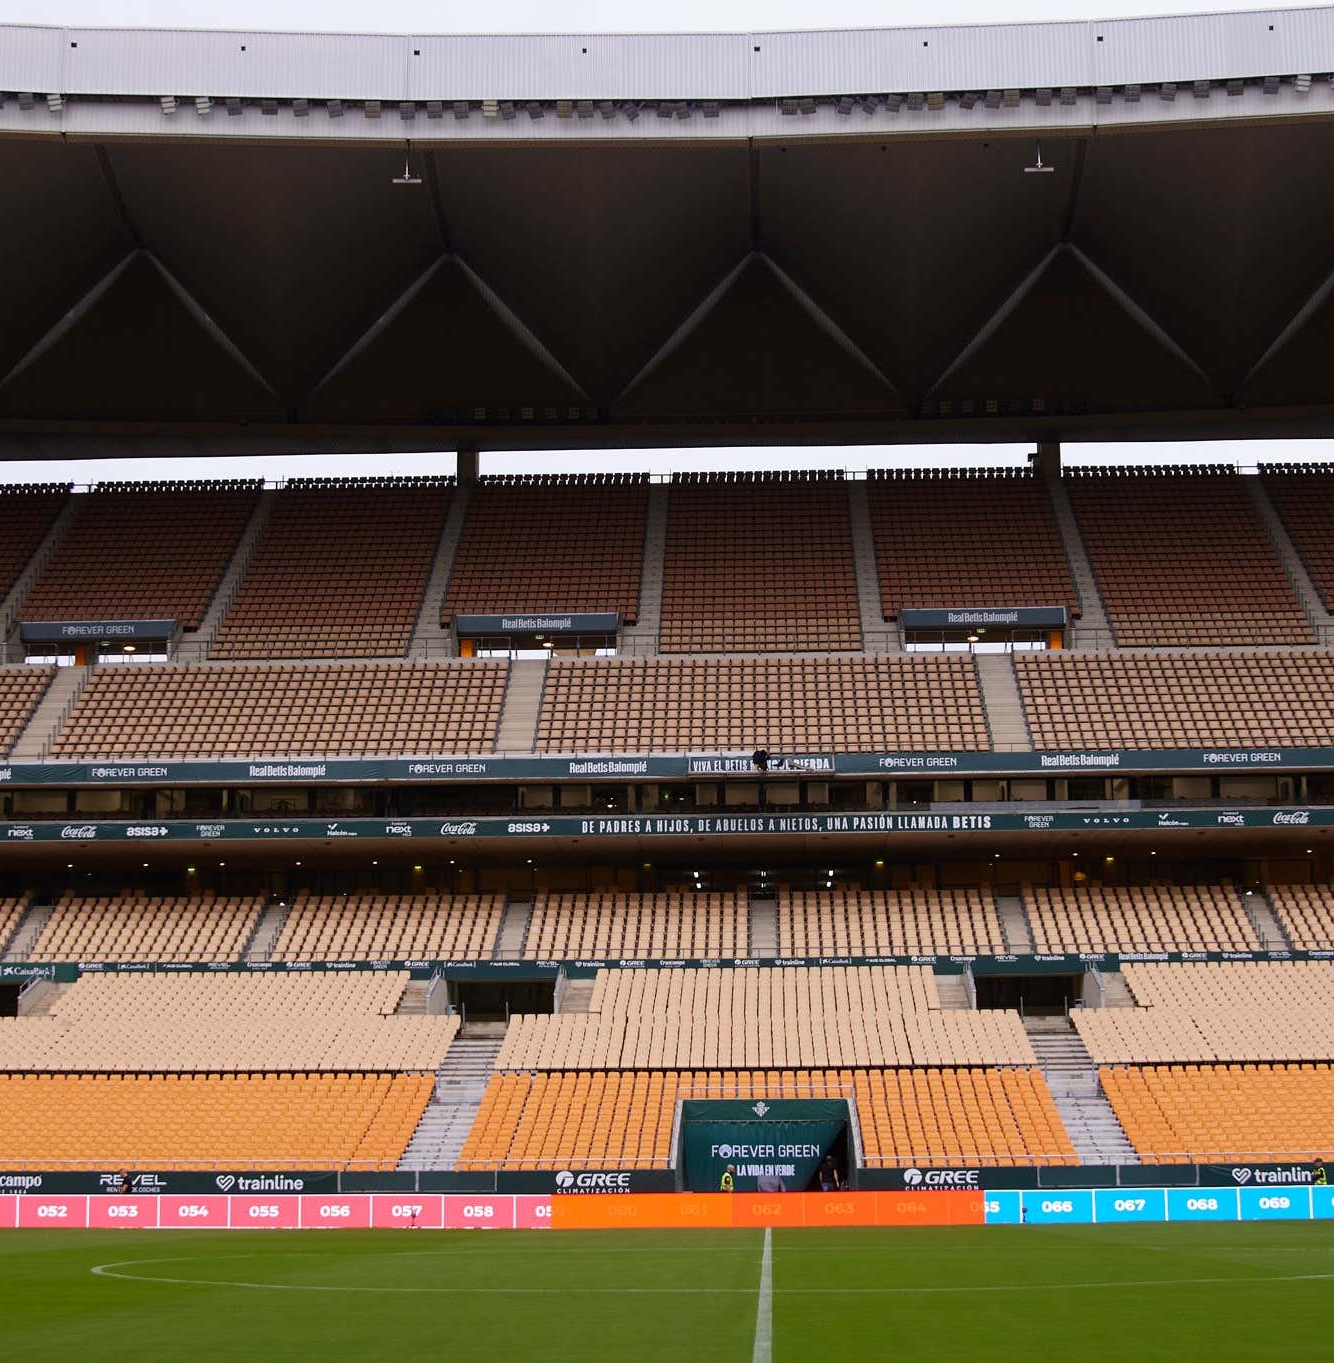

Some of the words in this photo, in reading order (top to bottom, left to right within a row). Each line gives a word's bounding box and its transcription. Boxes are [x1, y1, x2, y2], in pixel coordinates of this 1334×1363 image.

[503, 619, 518, 628] Real
[519, 619, 536, 628] Betis
[537, 619, 571, 628] Balompié
[62, 626, 104, 634] FOREVER
[879, 758, 924, 766] FOREVER
[926, 758, 957, 766] GREEN
[1203, 754, 1249, 762] FOREVER
[1250, 753, 1281, 761] GREEN
[91, 768, 136, 776] FOREVER
[137, 768, 168, 776] GREEN
[570, 763, 587, 773] Real
[588, 762, 608, 773] Betis
[609, 762, 646, 772] Balompié
[693, 761, 711, 774] VIVA
[714, 761, 722, 773] EL
[725, 761, 748, 773] BETIS
[440, 823, 478, 834] Coca-Cola
[507, 823, 541, 832] asisa
[582, 821, 594, 833] DE
[600, 821, 640, 832] PADRES
[646, 820, 651, 832] A
[657, 820, 693, 832] HIJOS,
[699, 819, 710, 831] DE
[716, 819, 763, 831] ABUELOS
[769, 819, 774, 830] A
[780, 818, 822, 830] NIETOS,
[827, 817, 848, 829] UNA
[854, 815, 892, 829] PASIÓN
[898, 817, 947, 828] LLAMADA
[953, 816, 991, 828] BETIS
[60, 826, 98, 838] Coca-Cola
[126, 827, 161, 836] asisa
[711, 1145, 775, 1157] FOREVER
[778, 1145, 820, 1157] GREEN
[737, 1165, 746, 1175] LA
[747, 1164, 764, 1176] VIDA
[765, 1165, 774, 1176] EN
[775, 1164, 795, 1176] VERDE
[1253, 1167, 1313, 1182] trainlin
[237, 1175, 304, 1190] trainline
[576, 1173, 632, 1186] GREE
[924, 1171, 980, 1184] GREE
[1041, 1201, 1073, 1212] 066
[1114, 1199, 1146, 1211] 067
[1186, 1199, 1219, 1210] 068
[1258, 1197, 1291, 1208] 069
[37, 1206, 68, 1217] 052
[107, 1206, 139, 1216] 053
[178, 1206, 209, 1216] 054
[249, 1206, 280, 1217] 055
[319, 1206, 351, 1216] 056
[391, 1206, 423, 1216] 057
[463, 1206, 494, 1217] 058
